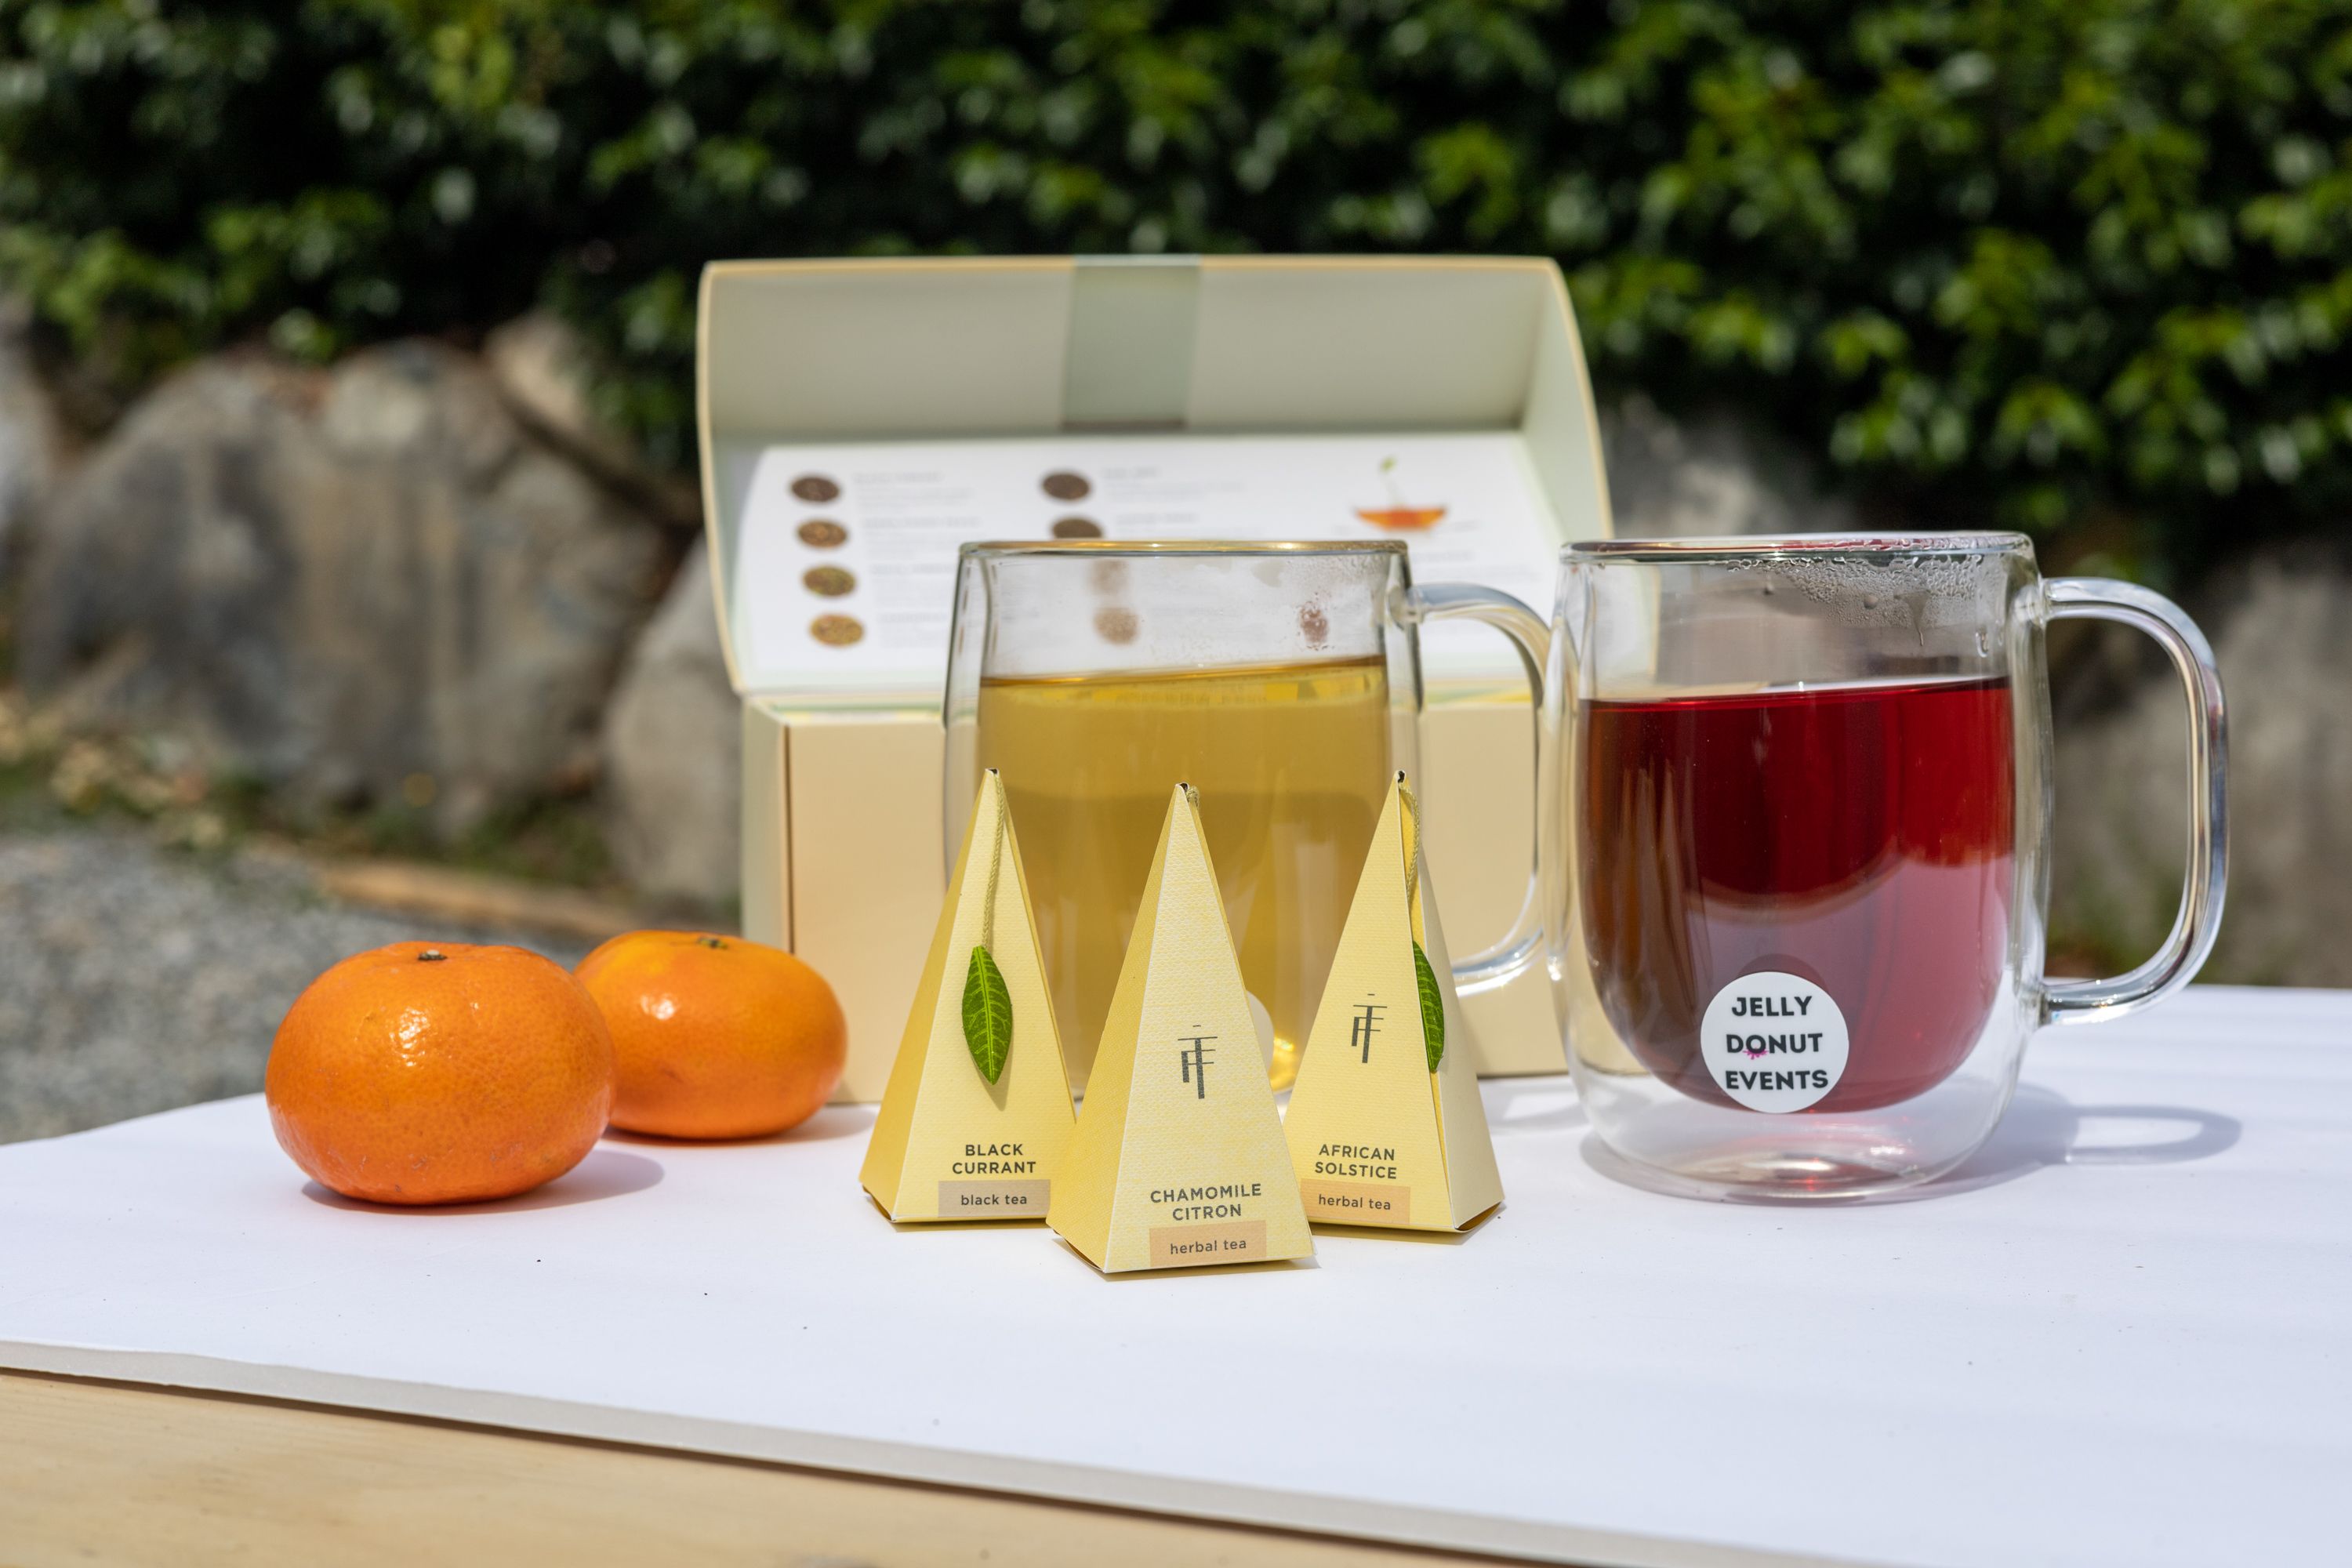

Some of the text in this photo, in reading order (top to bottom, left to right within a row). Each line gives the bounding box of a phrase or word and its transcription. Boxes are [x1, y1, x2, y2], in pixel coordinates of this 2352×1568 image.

[1731, 995, 1813, 1017] JELLY
[1726, 1033, 1823, 1054] DONUT
[1725, 1069, 1829, 1091] EVENTS
[965, 1143, 1024, 1156] BLACK
[1319, 1144, 1396, 1161] AFRICAN
[952, 1160, 1036, 1174] CURRANT
[1314, 1161, 1397, 1180] SOLSTICE
[960, 1194, 1028, 1206] black tea
[1149, 1183, 1262, 1204] CHAMOMILE
[1318, 1193, 1392, 1210] herbal tea
[1172, 1203, 1243, 1221] CITRON
[1170, 1239, 1247, 1255] herbal tea
